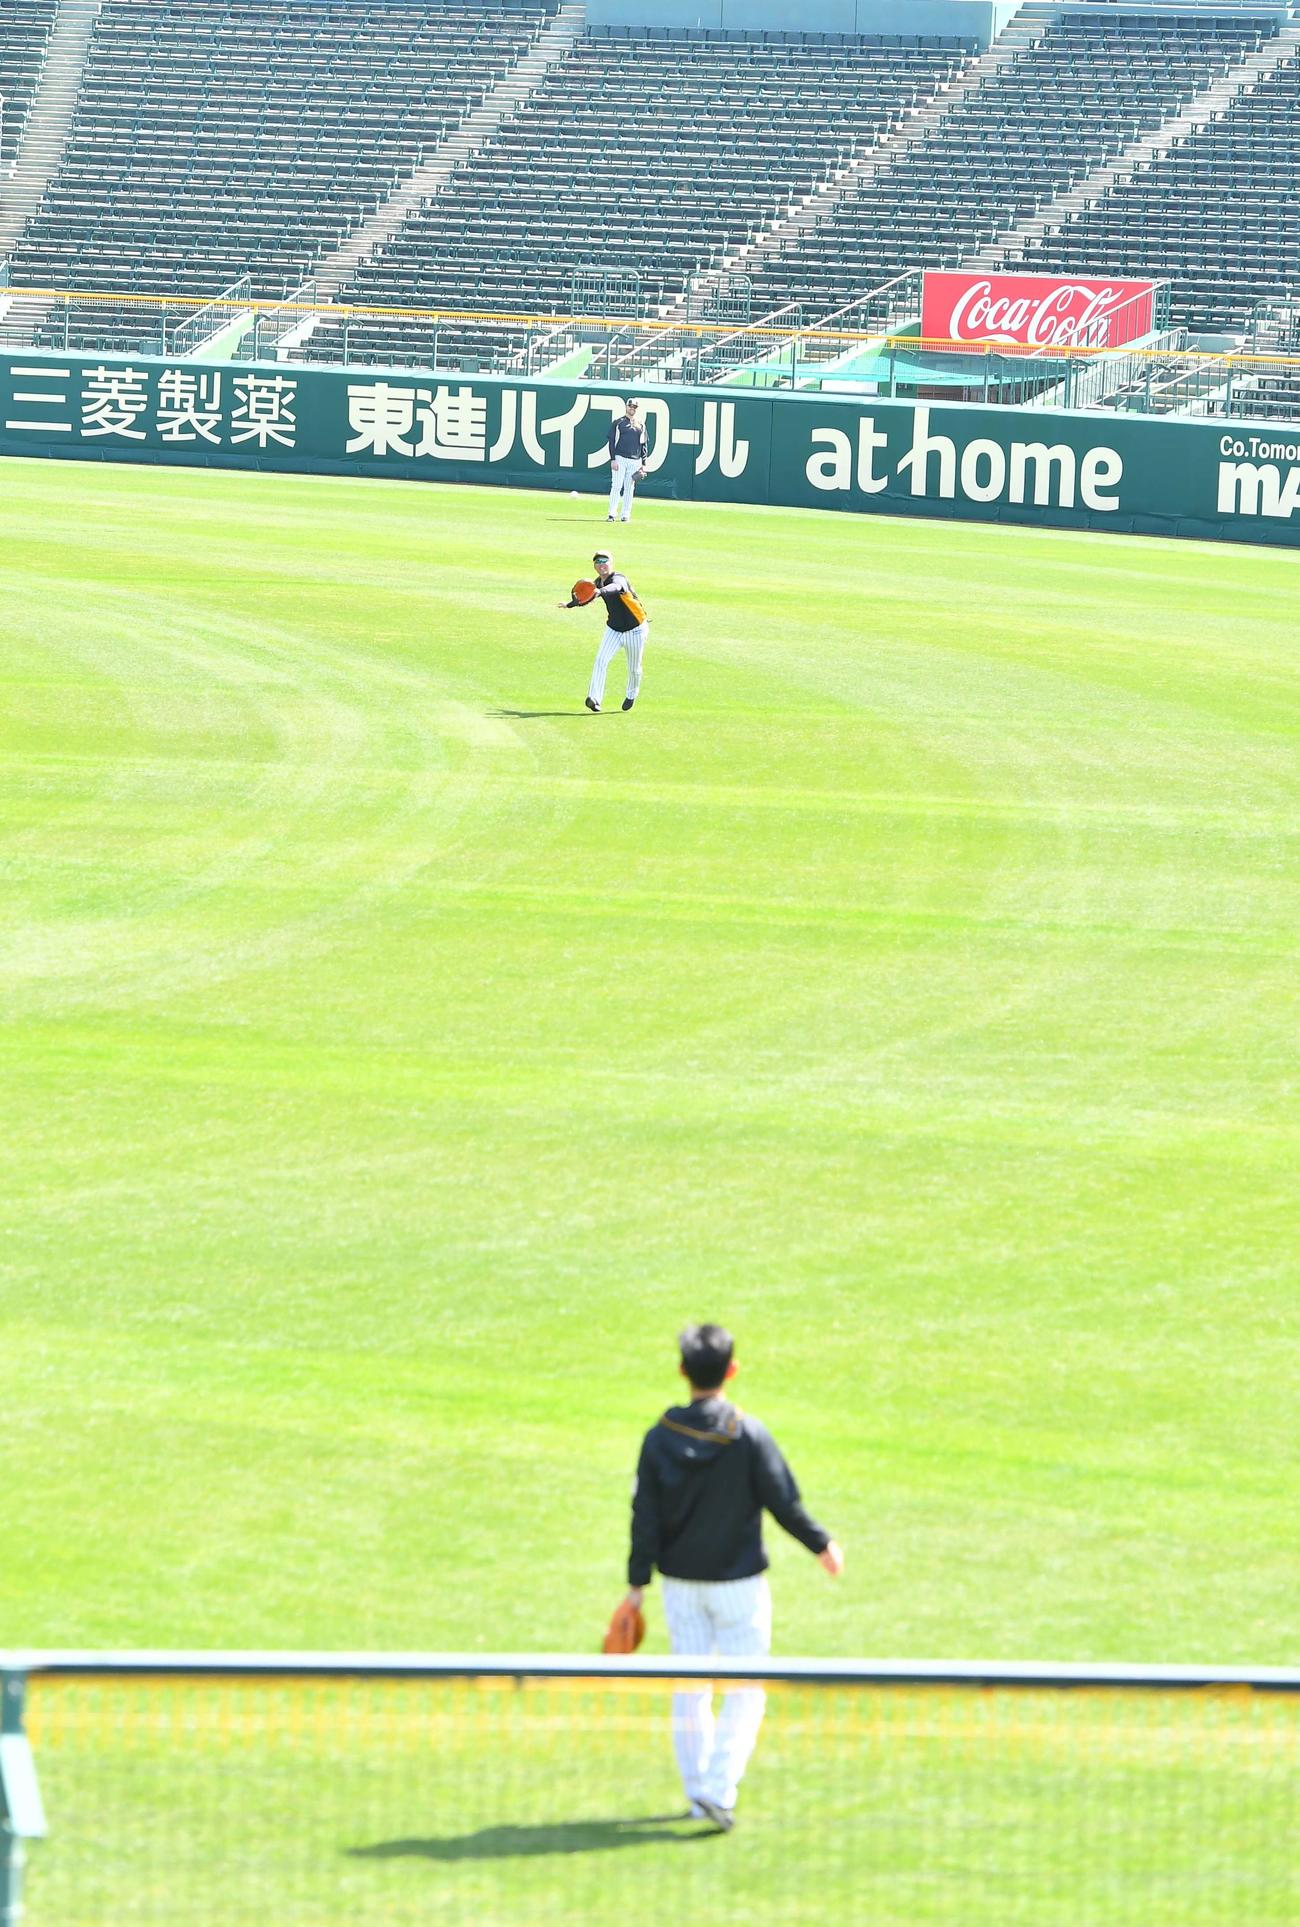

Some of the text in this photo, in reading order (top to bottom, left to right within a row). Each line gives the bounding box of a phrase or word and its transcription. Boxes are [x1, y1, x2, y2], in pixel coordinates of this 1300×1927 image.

[949, 280, 1124, 347] Coca-Cola
[5, 365, 298, 448] 三菱製薬
[805, 406, 1123, 512] at home
